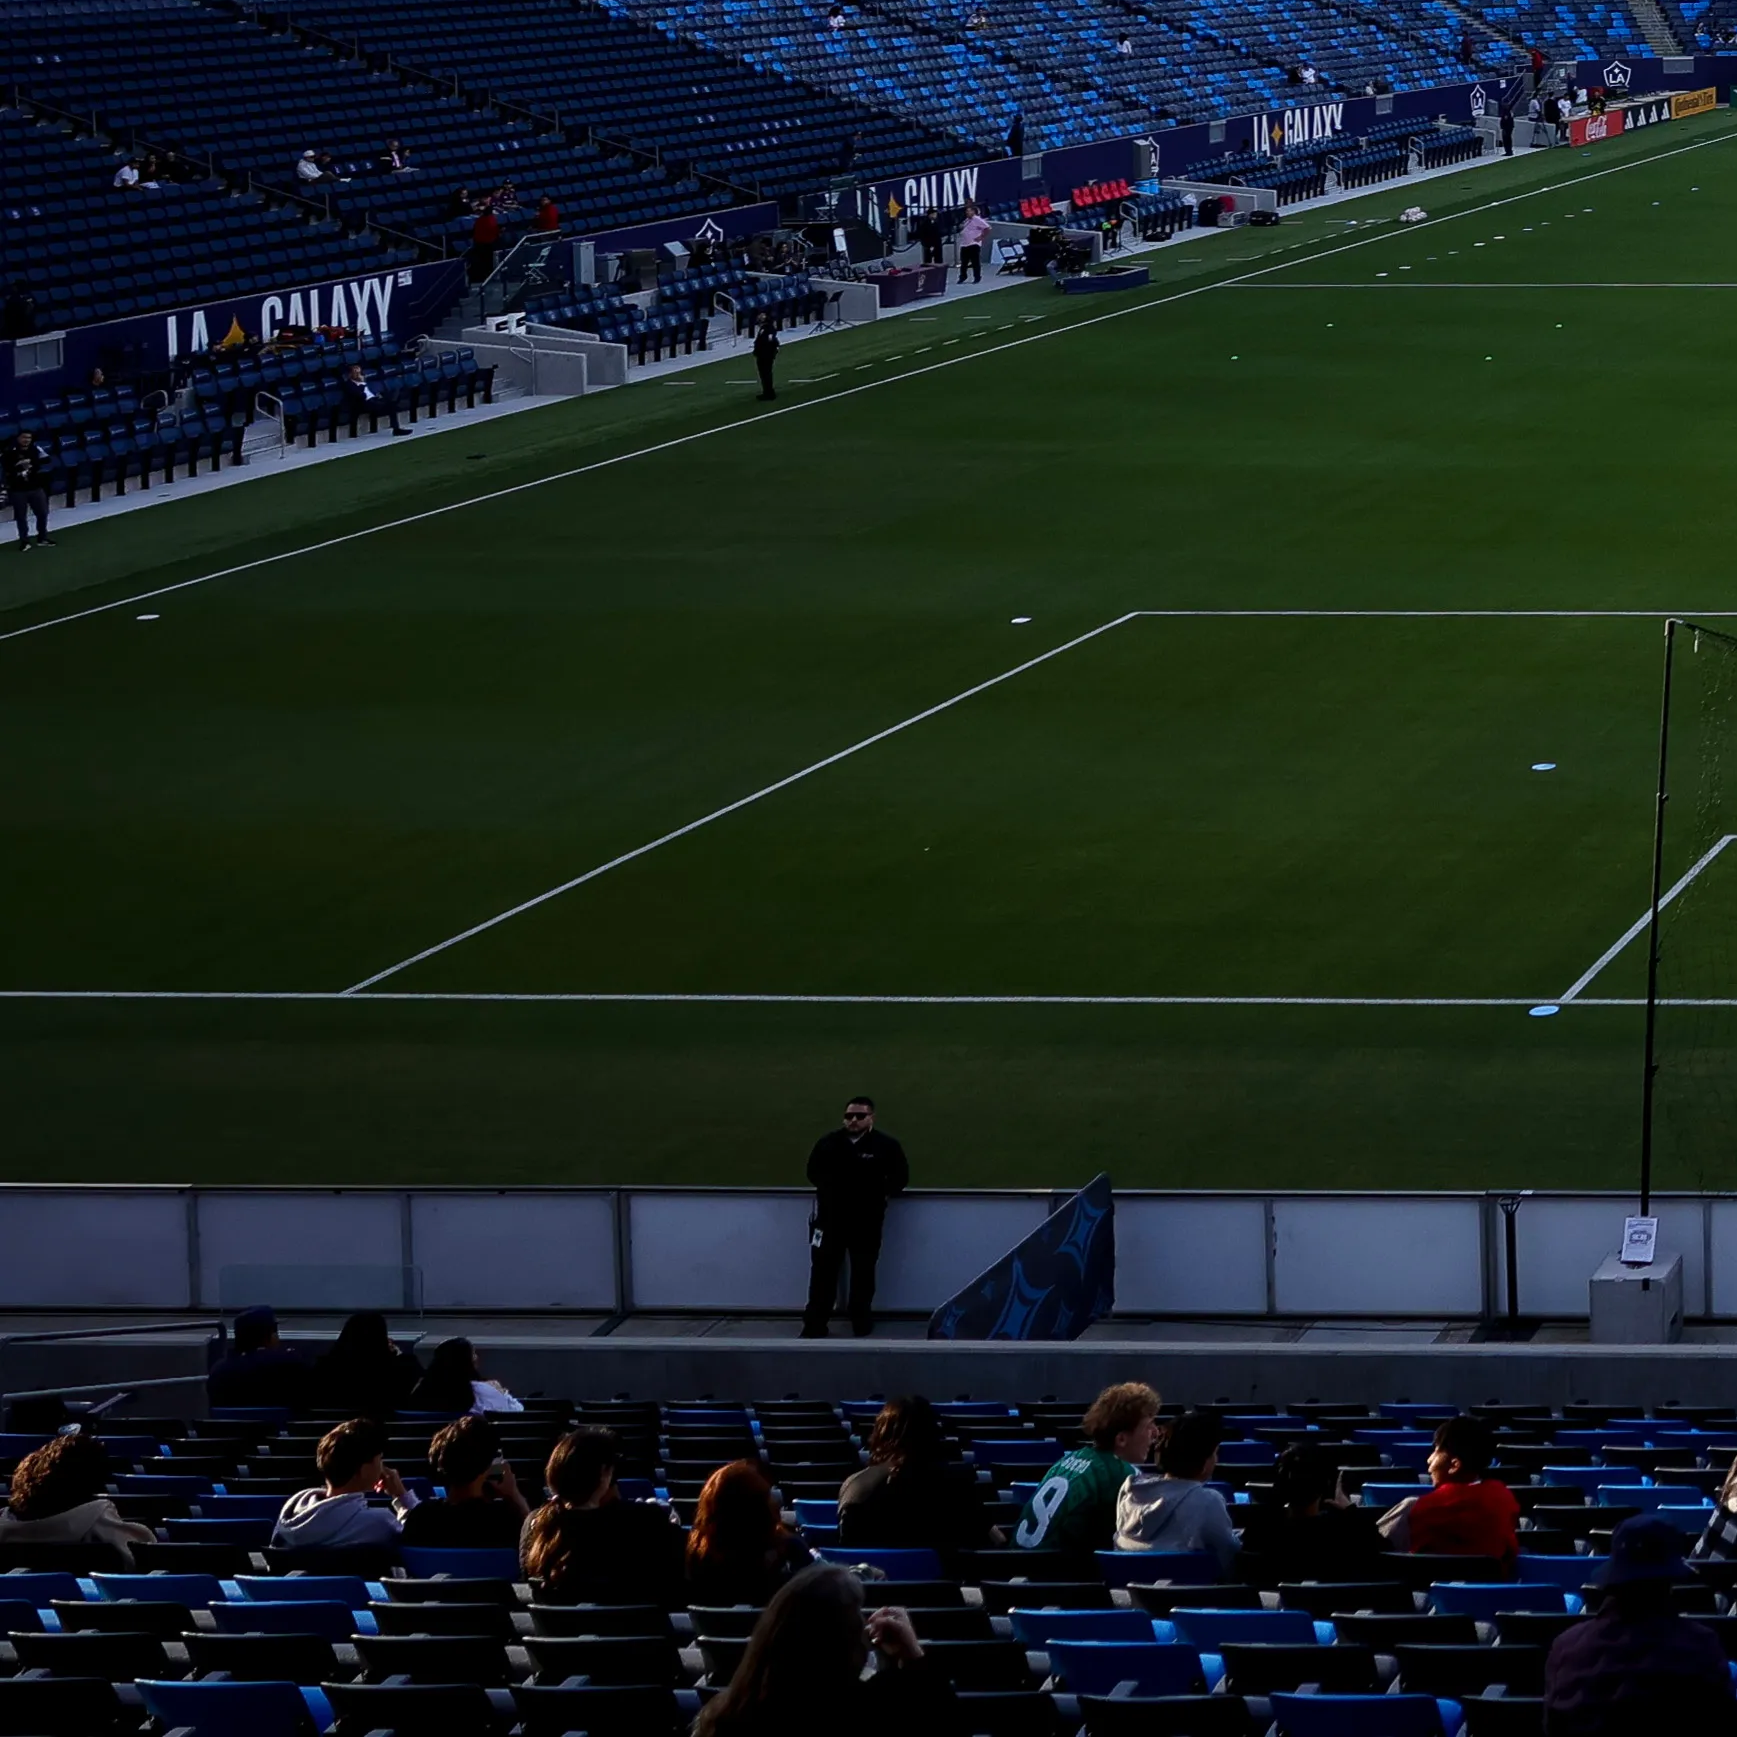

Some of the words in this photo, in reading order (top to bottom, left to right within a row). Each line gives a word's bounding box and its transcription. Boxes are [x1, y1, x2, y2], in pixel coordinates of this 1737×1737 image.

[1609, 74, 1625, 84] LA
[1284, 103, 1344, 146] GALAXY
[261, 275, 394, 344] GALAXY
[1016, 1476, 1069, 1549] 9
